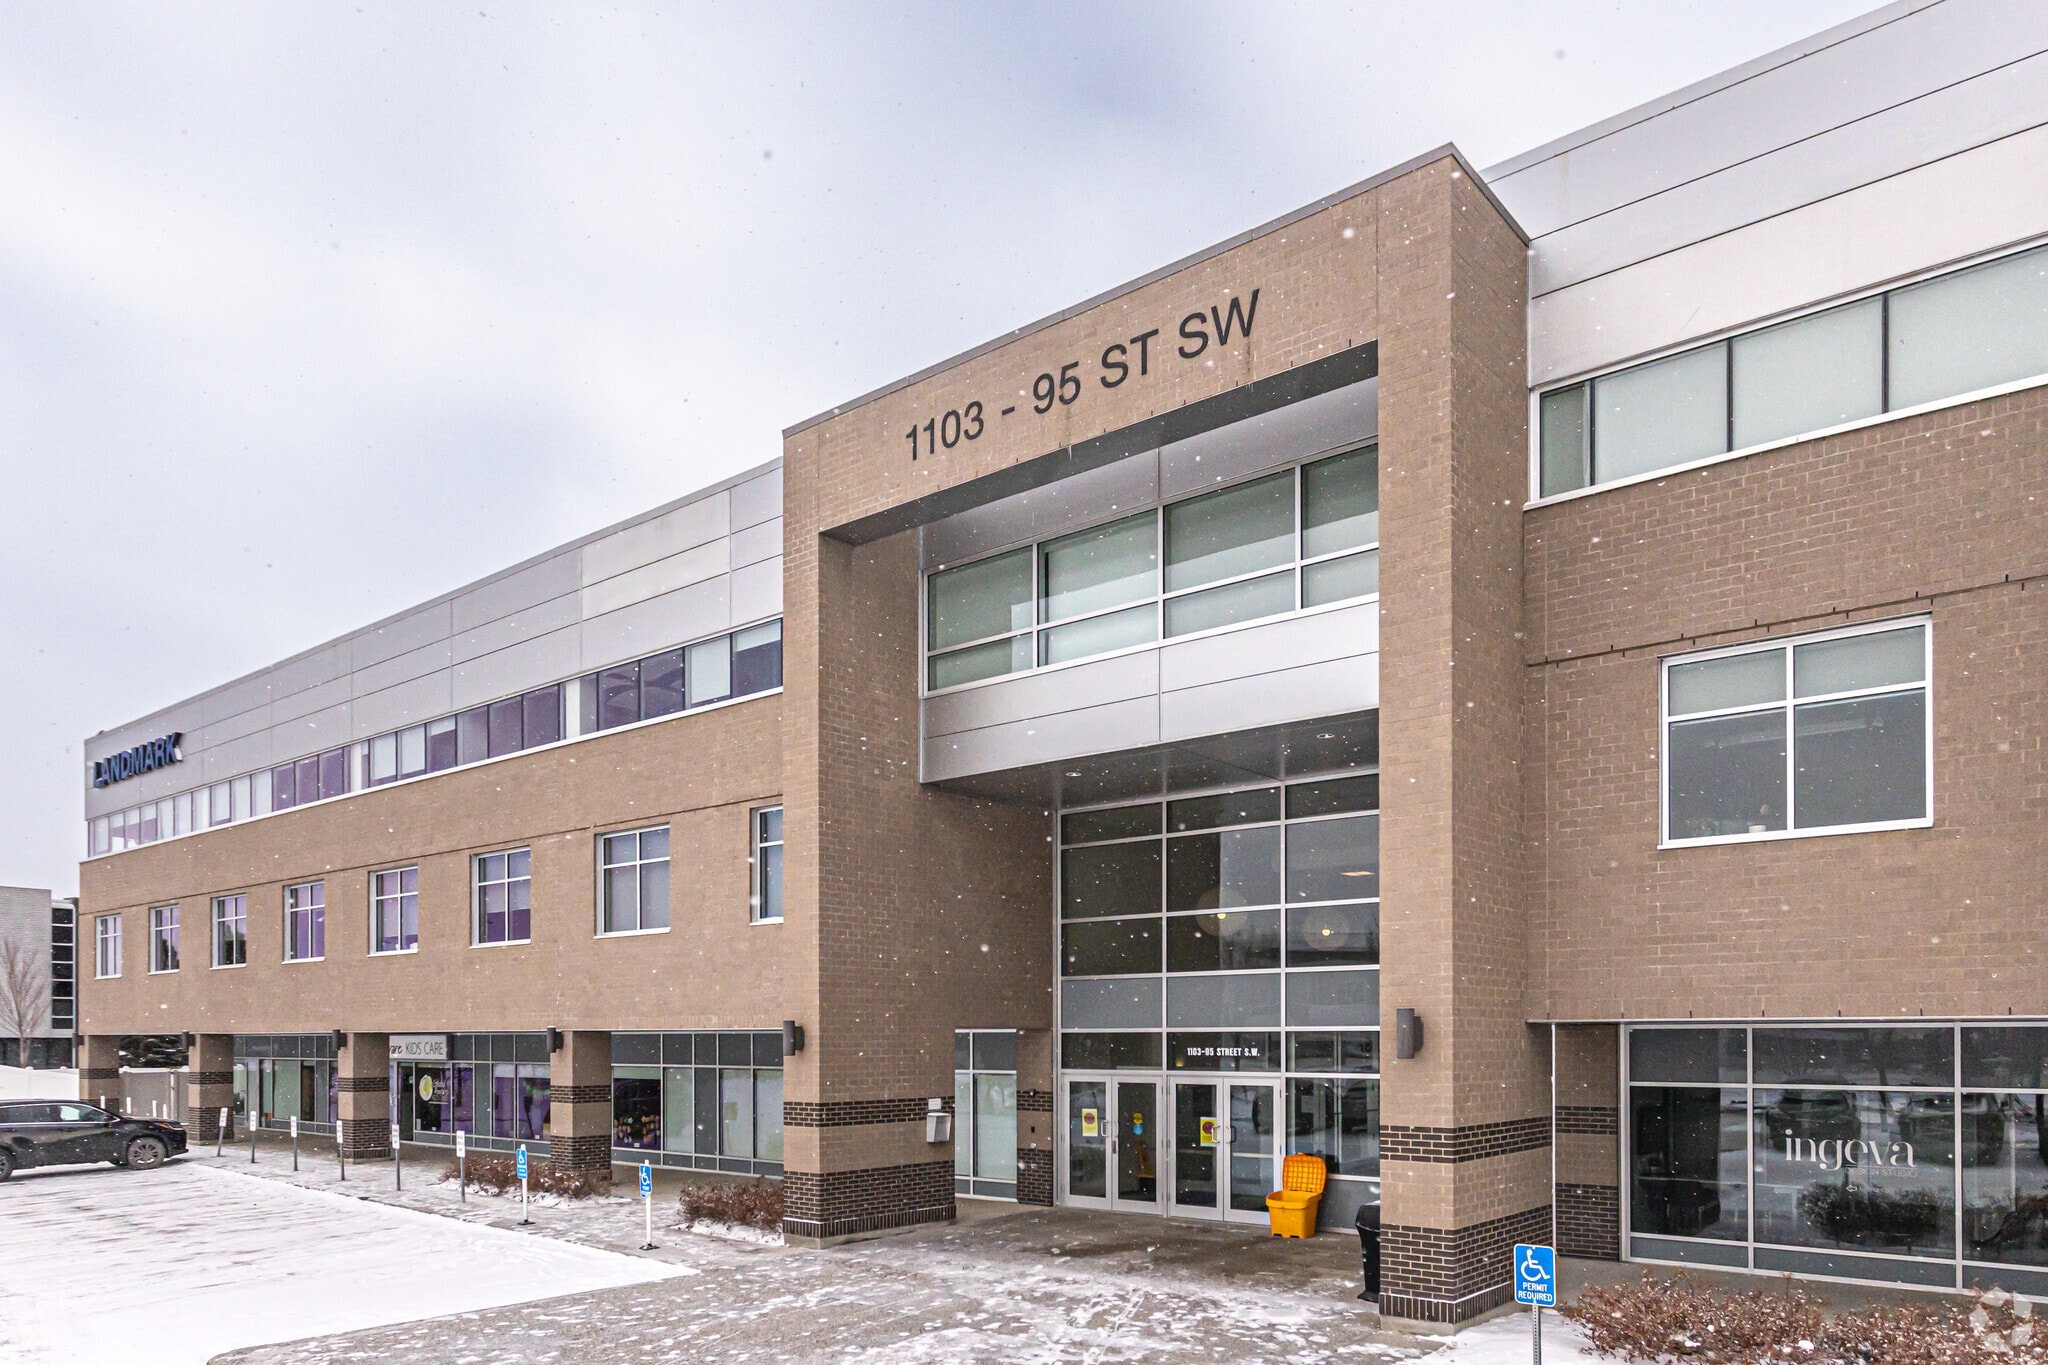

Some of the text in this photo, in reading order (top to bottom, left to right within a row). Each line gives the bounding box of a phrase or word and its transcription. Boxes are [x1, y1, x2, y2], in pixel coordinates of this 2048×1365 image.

[905, 400, 985, 461] 1103
[1033, 361, 1081, 414] 95
[1100, 328, 1160, 388] ST
[1178, 288, 1260, 359] SW
[93, 732, 182, 788] LANDMARK
[405, 1042, 421, 1055] KIDS
[423, 1042, 444, 1056] CARE
[1216, 1047, 1242, 1056] STREET
[1244, 1047, 1260, 1056] S.W.
[1785, 1128, 1917, 1171] ingeva
[1845, 1167, 1879, 1176] DESN
[1522, 1282, 1548, 1292] PERMIT
[1518, 1290, 1553, 1302] REQUIRED
